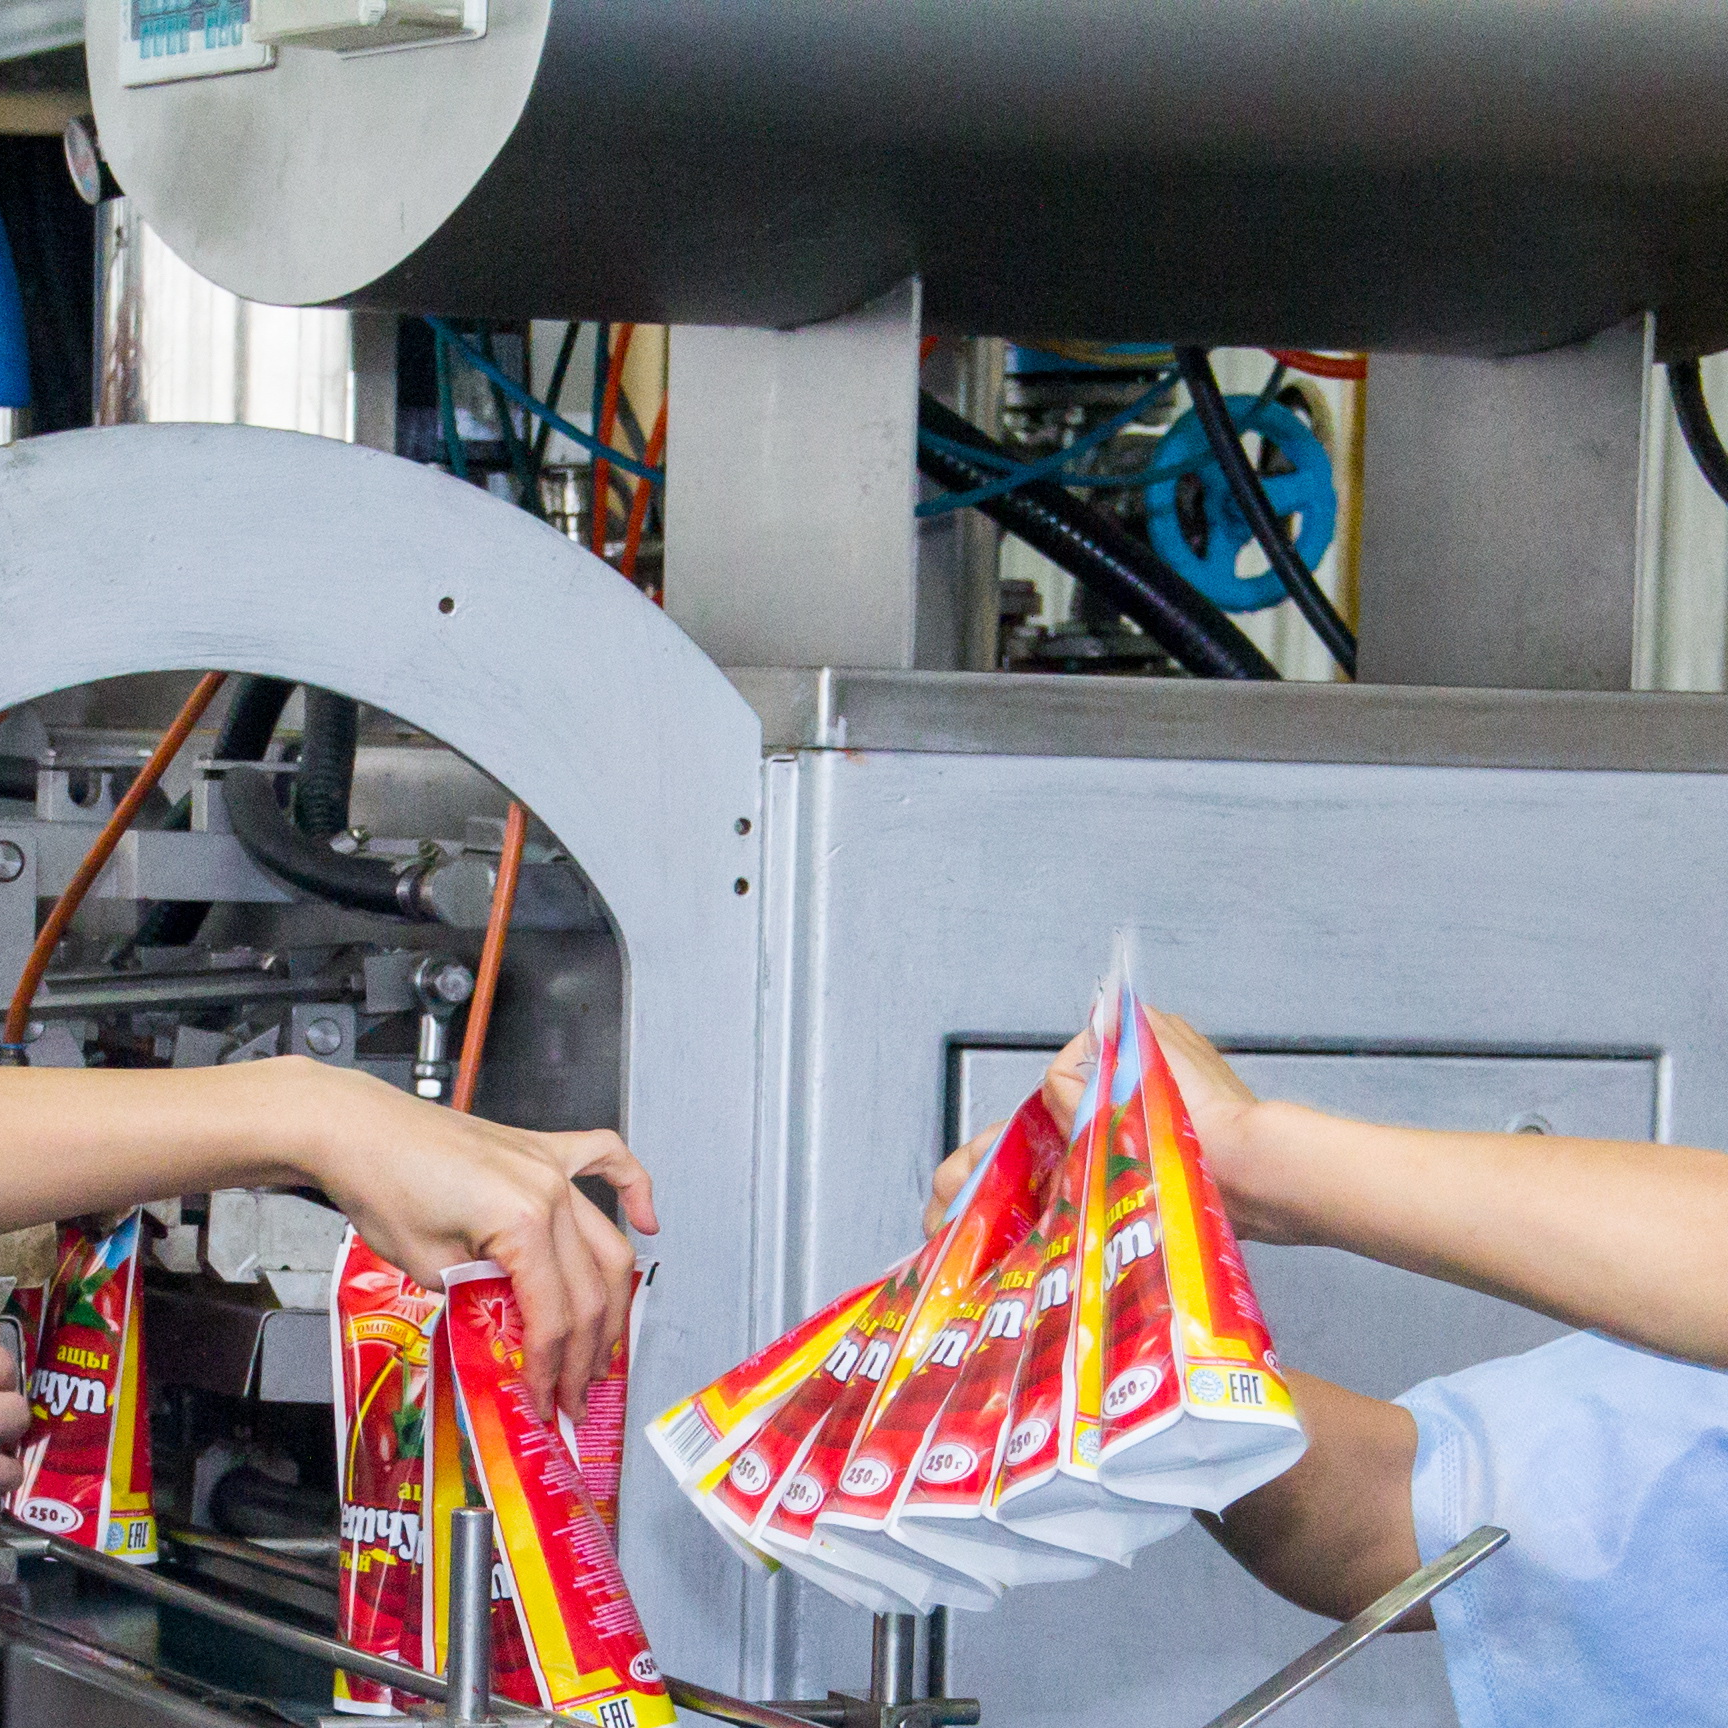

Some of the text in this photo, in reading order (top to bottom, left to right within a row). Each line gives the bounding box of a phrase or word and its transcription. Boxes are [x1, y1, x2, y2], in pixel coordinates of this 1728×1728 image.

[1106, 1190, 1146, 1227] щы
[57, 1345, 110, 1371] ащы
[31, 1369, 107, 1416] чуп
[1108, 1379, 1137, 1408] 250
[1009, 1432, 1031, 1454] 250
[735, 1457, 757, 1480] 250
[925, 1454, 953, 1472] 250
[846, 1467, 873, 1484] 250
[786, 1481, 807, 1501] 250
[29, 1505, 59, 1522] 250
[341, 1503, 425, 1565] етчу
[340, 1550, 371, 1573] рый
